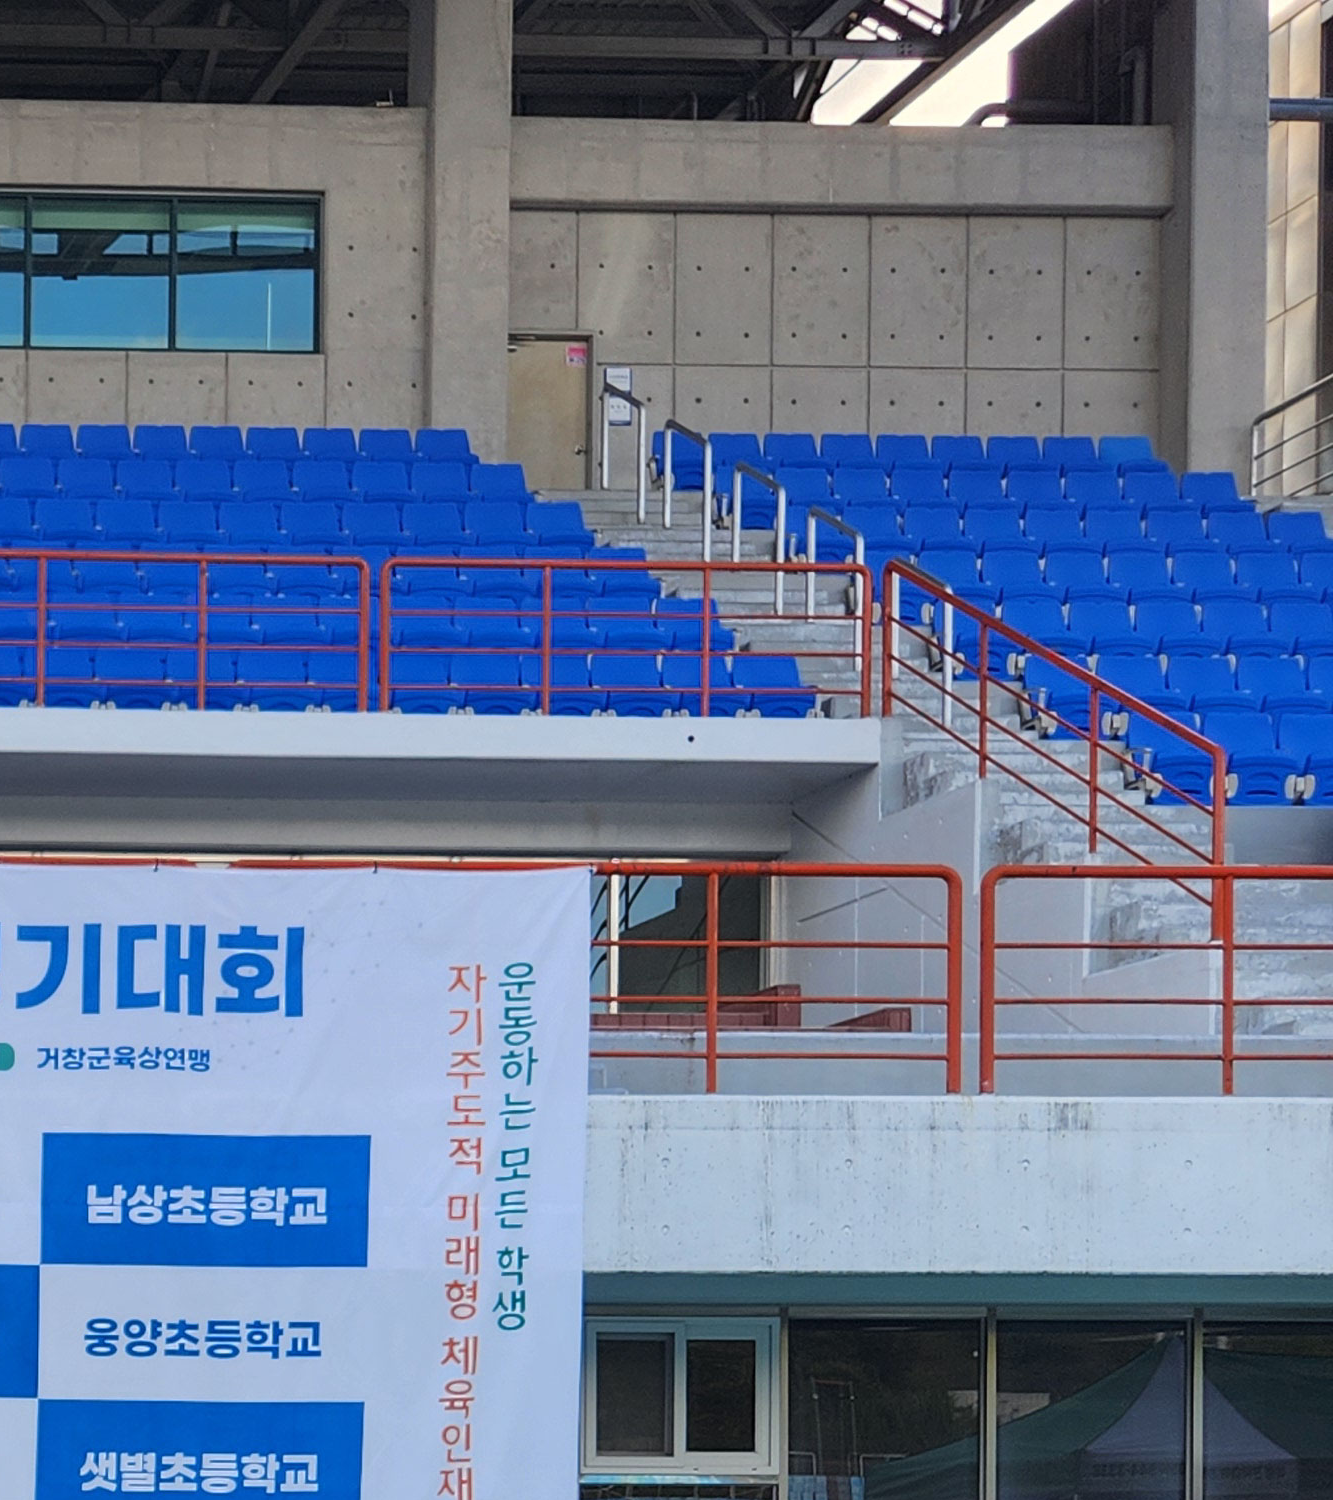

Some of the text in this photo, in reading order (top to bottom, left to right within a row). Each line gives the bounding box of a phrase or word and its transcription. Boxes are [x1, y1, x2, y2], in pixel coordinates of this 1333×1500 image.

[38, 1046, 210, 1072] 거창군육상연맹
[447, 965, 487, 1174] 자기주도적
[493, 963, 538, 1330] 운동하는 모든 학생
[87, 1185, 327, 1226] 남상초등학교
[445, 1194, 479, 1320] 미래형
[84, 1319, 321, 1359] 웅양초등학교
[80, 1452, 318, 1493] 샛별초등학교
